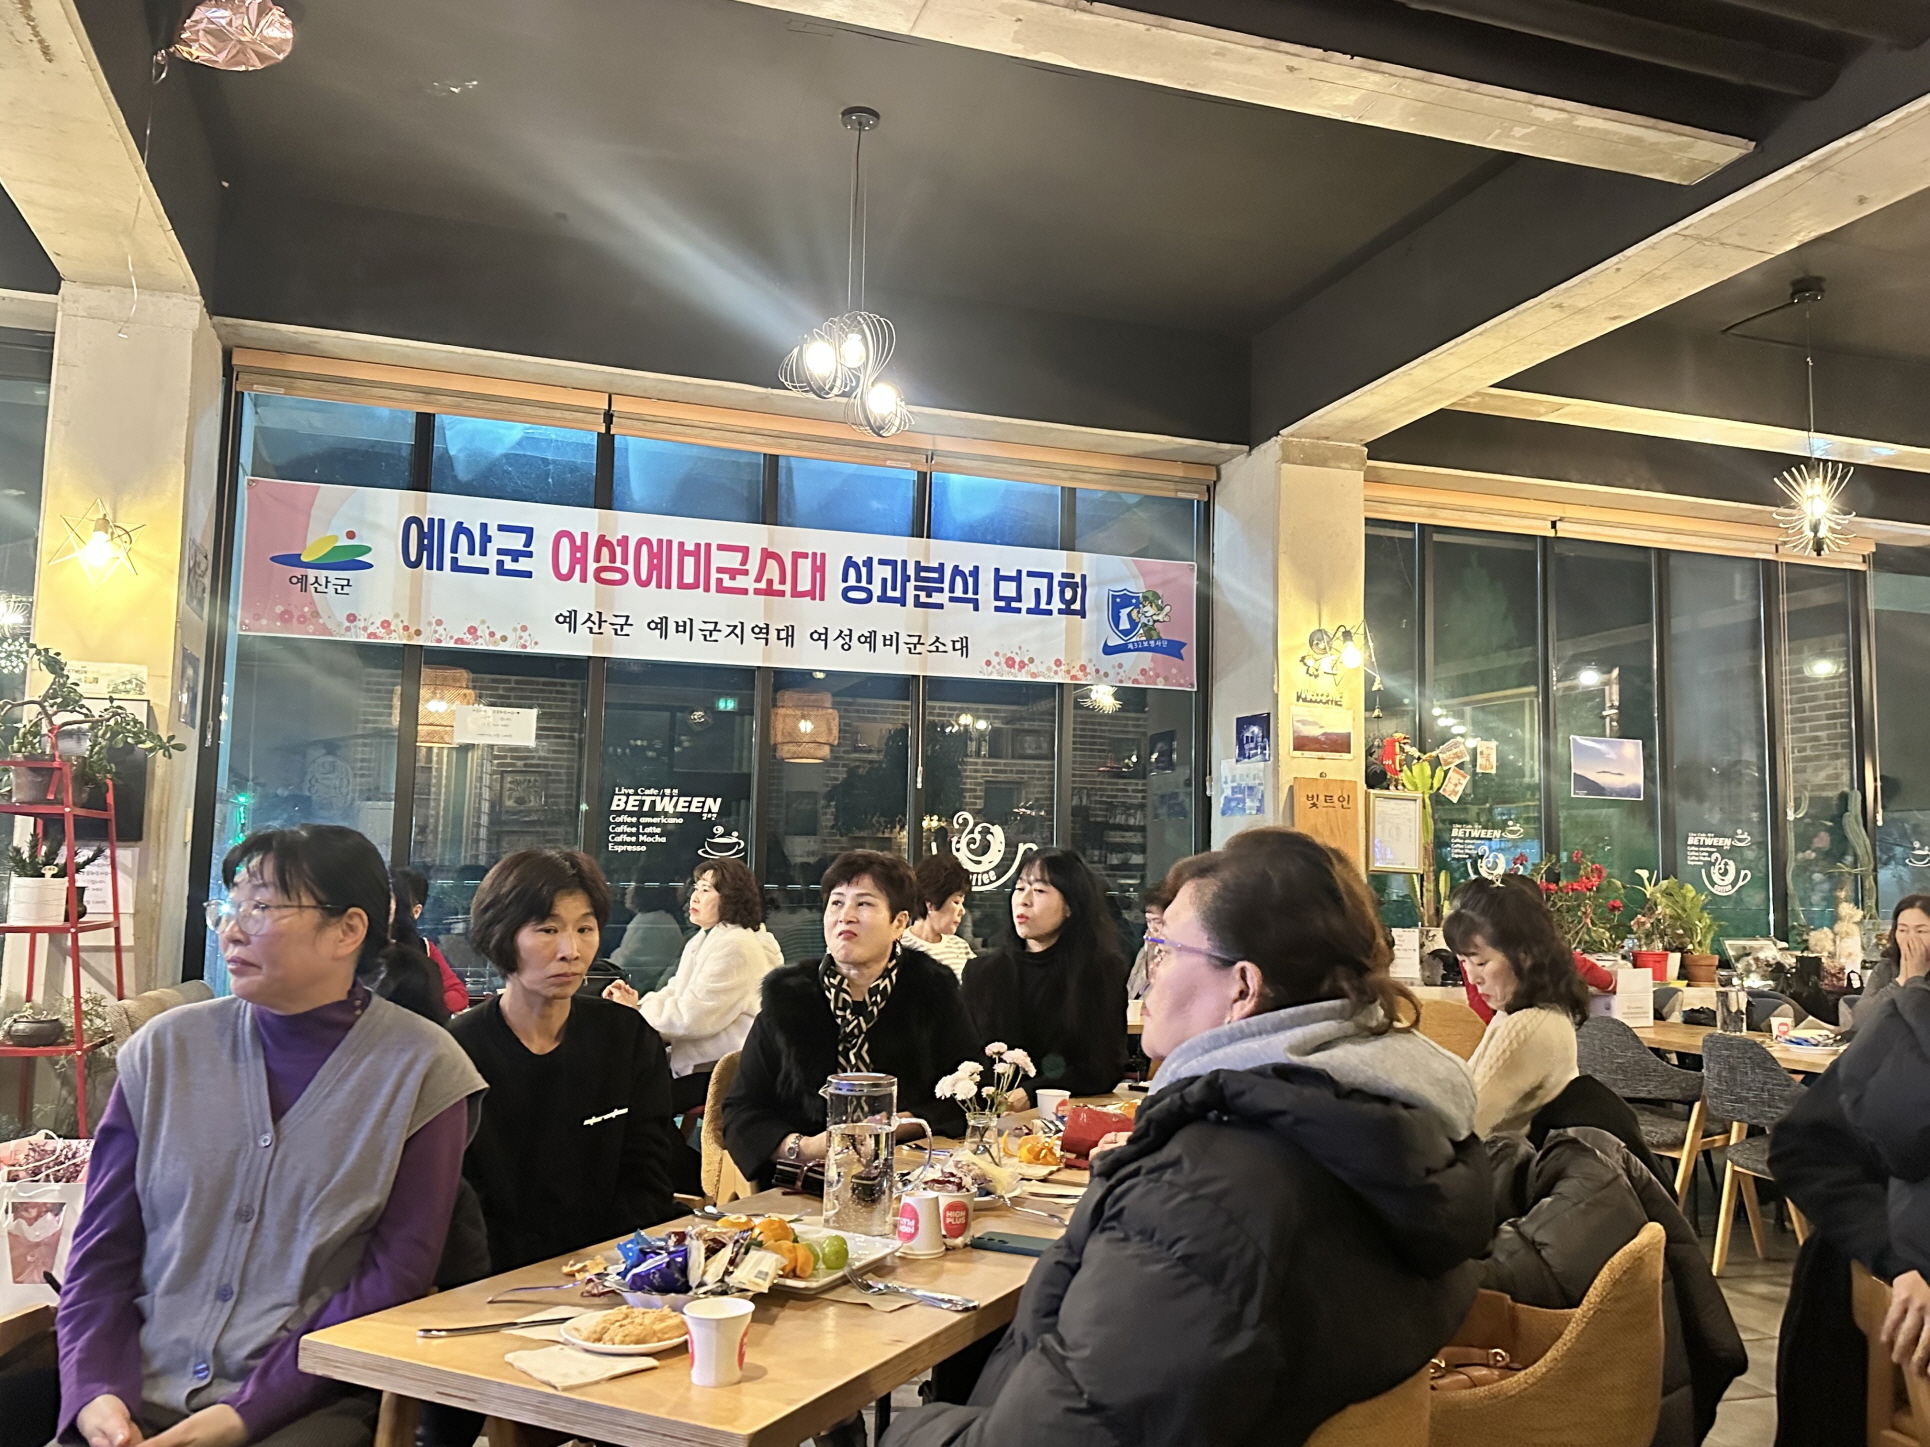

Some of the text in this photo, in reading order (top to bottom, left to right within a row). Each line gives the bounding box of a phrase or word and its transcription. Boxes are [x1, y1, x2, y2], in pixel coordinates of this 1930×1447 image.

[401, 515, 1087, 619] 예산군 여성예비군소대 성과분석 보고회
[288, 573, 353, 596] 예산군
[554, 608, 970, 659] 예산군 예비군지역대 여성예비군소대
[610, 795, 722, 813] BETWEEN
[1306, 793, 1351, 810] 빛트인
[609, 815, 637, 823] Coffee
[639, 825, 662, 833] Latte
[1451, 828, 1501, 838] BETWEEN
[639, 834, 667, 843] Mocha
[1687, 836, 1732, 846] BETWEEN
[608, 843, 647, 853] Espresso
